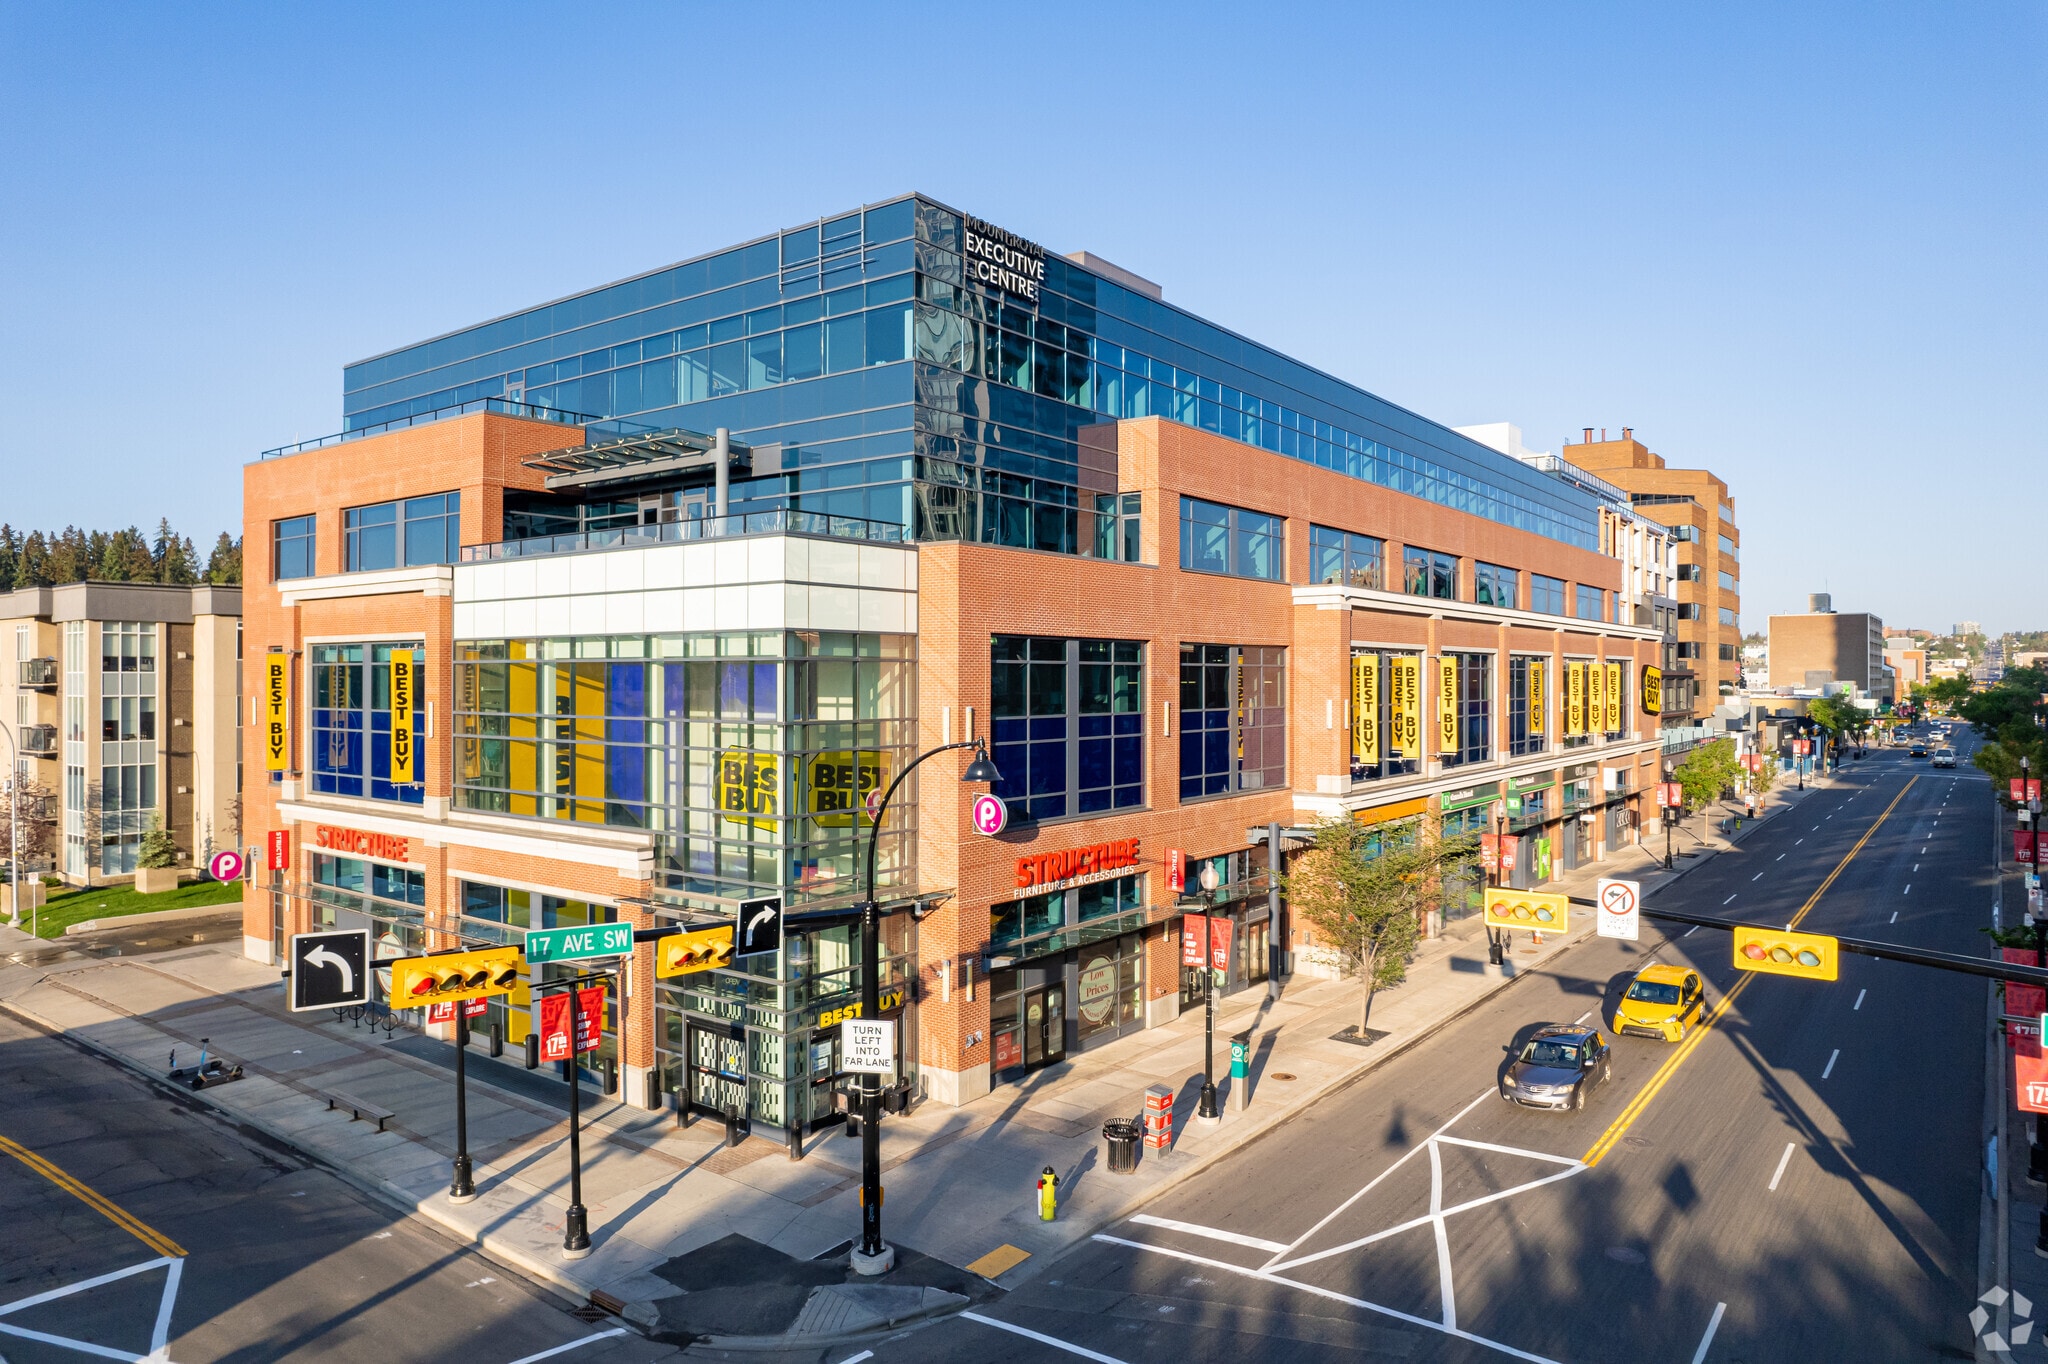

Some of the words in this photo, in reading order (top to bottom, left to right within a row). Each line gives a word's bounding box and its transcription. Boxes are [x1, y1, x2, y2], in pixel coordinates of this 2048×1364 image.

[966, 231, 1045, 281] EXECUTIVE
[977, 260, 1035, 299] CENTRE
[271, 664, 283, 715] BEST
[395, 662, 409, 720] BEST
[1363, 665, 1373, 713] BEST
[1405, 666, 1416, 711] BEST
[1443, 666, 1453, 708] BEST
[1592, 670, 1600, 701] BEST
[1609, 670, 1617, 700] BEST
[1647, 673, 1660, 690] BEST
[1647, 689, 1659, 704] BUY
[1443, 714, 1453, 743] BUY
[1592, 705, 1600, 727] BUY
[1609, 703, 1617, 725] BUY
[271, 722, 283, 759] BUY
[1363, 719, 1373, 753] BUY
[1405, 717, 1416, 748] BUY
[395, 728, 409, 770] BUY
[724, 760, 778, 792] BES
[814, 763, 889, 790] BEST
[981, 801, 996, 828] P
[275, 831, 283, 869] STRUCTUBE
[316, 825, 409, 863] STRUCTUBE
[219, 855, 236, 878] P
[1014, 838, 1140, 888] STRUCTUBE
[1013, 879, 1066, 900] FURNITURE
[1068, 878, 1075, 887] &
[1078, 865, 1135, 885] ACCESSORIES
[531, 937, 551, 957] 17
[562, 932, 595, 954] AVE
[603, 928, 629, 949] SW
[1086, 984, 1109, 998] Prices
[577, 1011, 588, 1021] EAT
[820, 1002, 863, 1029] BEST
[577, 1030, 590, 1040] PLAY
[577, 1037, 599, 1050] EXPLORE
[853, 1026, 882, 1035] TURN
[854, 1036, 881, 1045] LEFT
[845, 1057, 863, 1066] FAR
[866, 1058, 891, 1067] LANE
[855, 1047, 880, 1056] INTO
